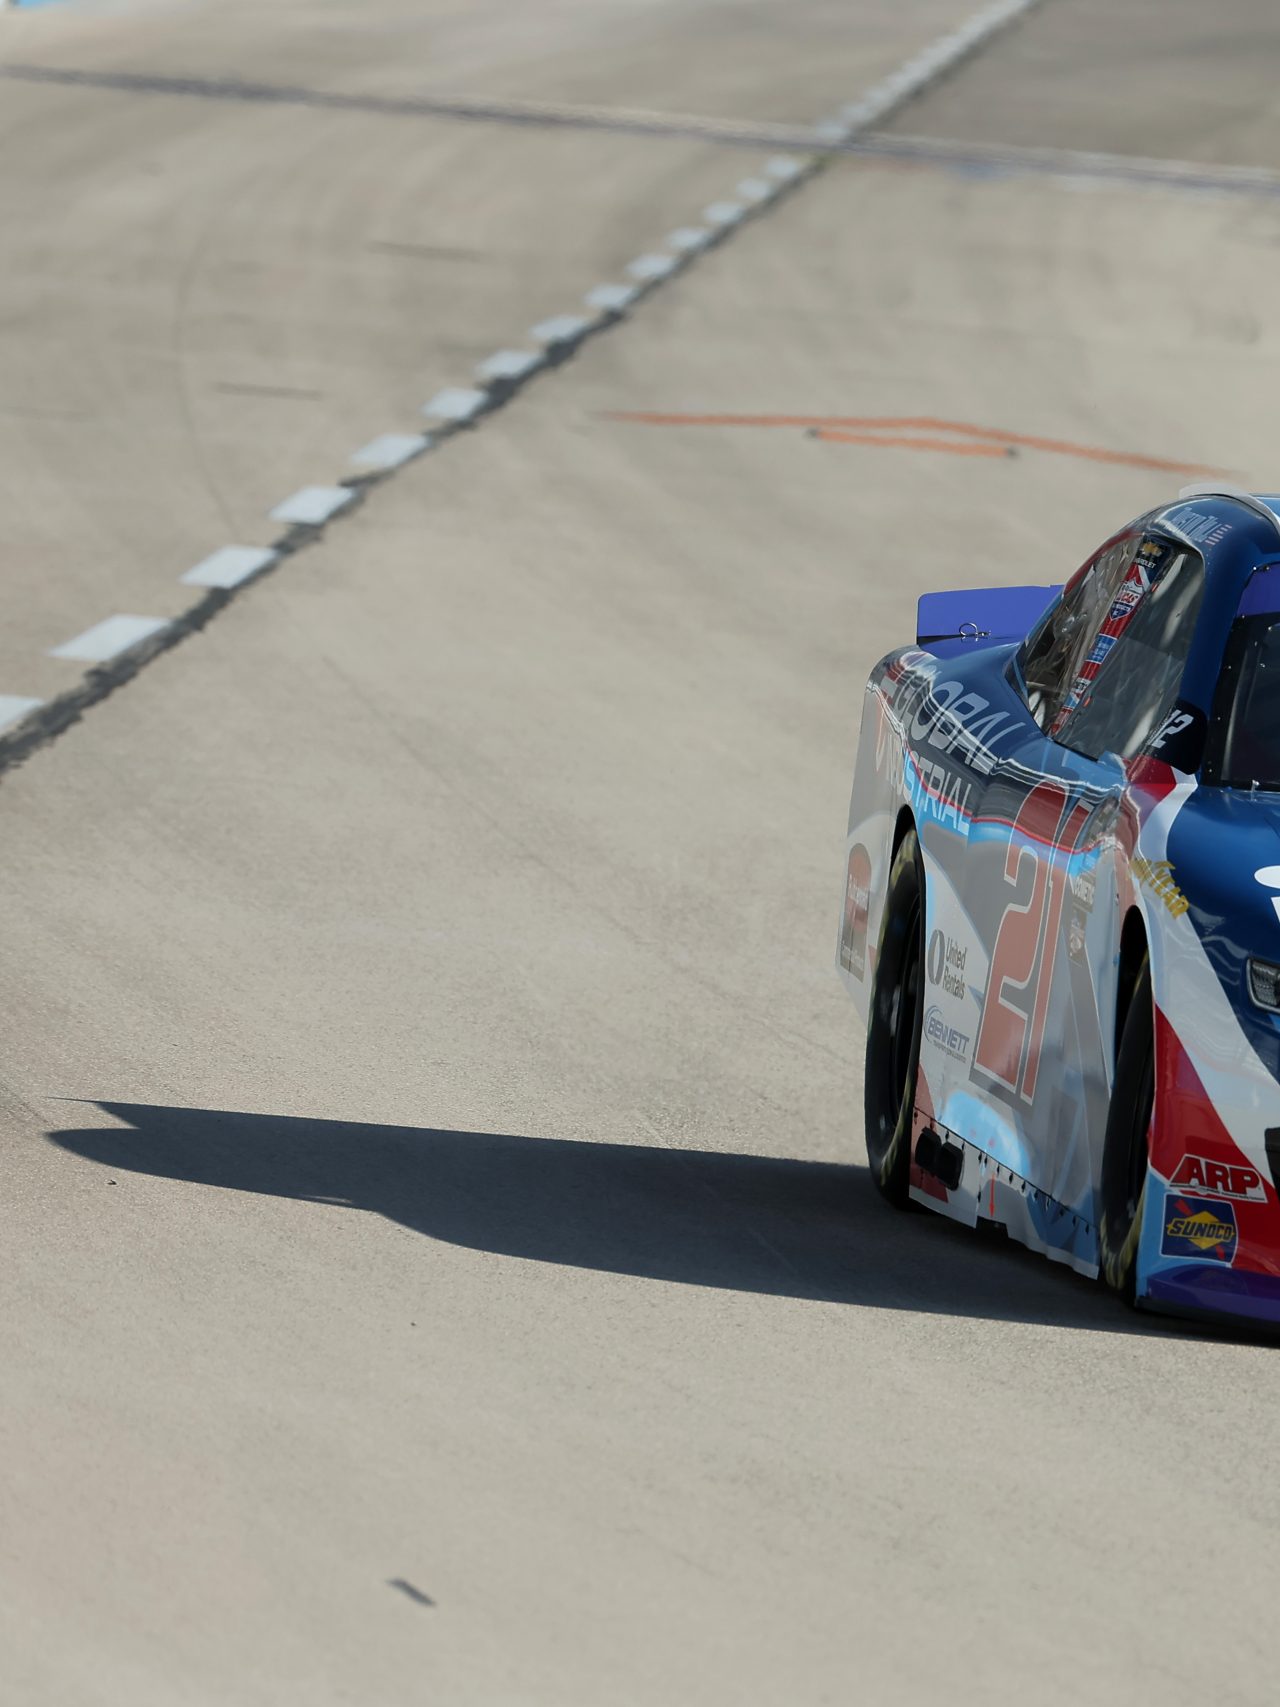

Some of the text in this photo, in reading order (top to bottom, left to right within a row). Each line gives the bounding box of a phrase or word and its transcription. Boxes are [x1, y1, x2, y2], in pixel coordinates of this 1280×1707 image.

[945, 937, 968, 971] United
[974, 779, 1095, 1107] 21
[927, 1016, 970, 1054] BENNETT
[1169, 1155, 1261, 1196] ARP
[1167, 1218, 1235, 1242] SUNOCO
